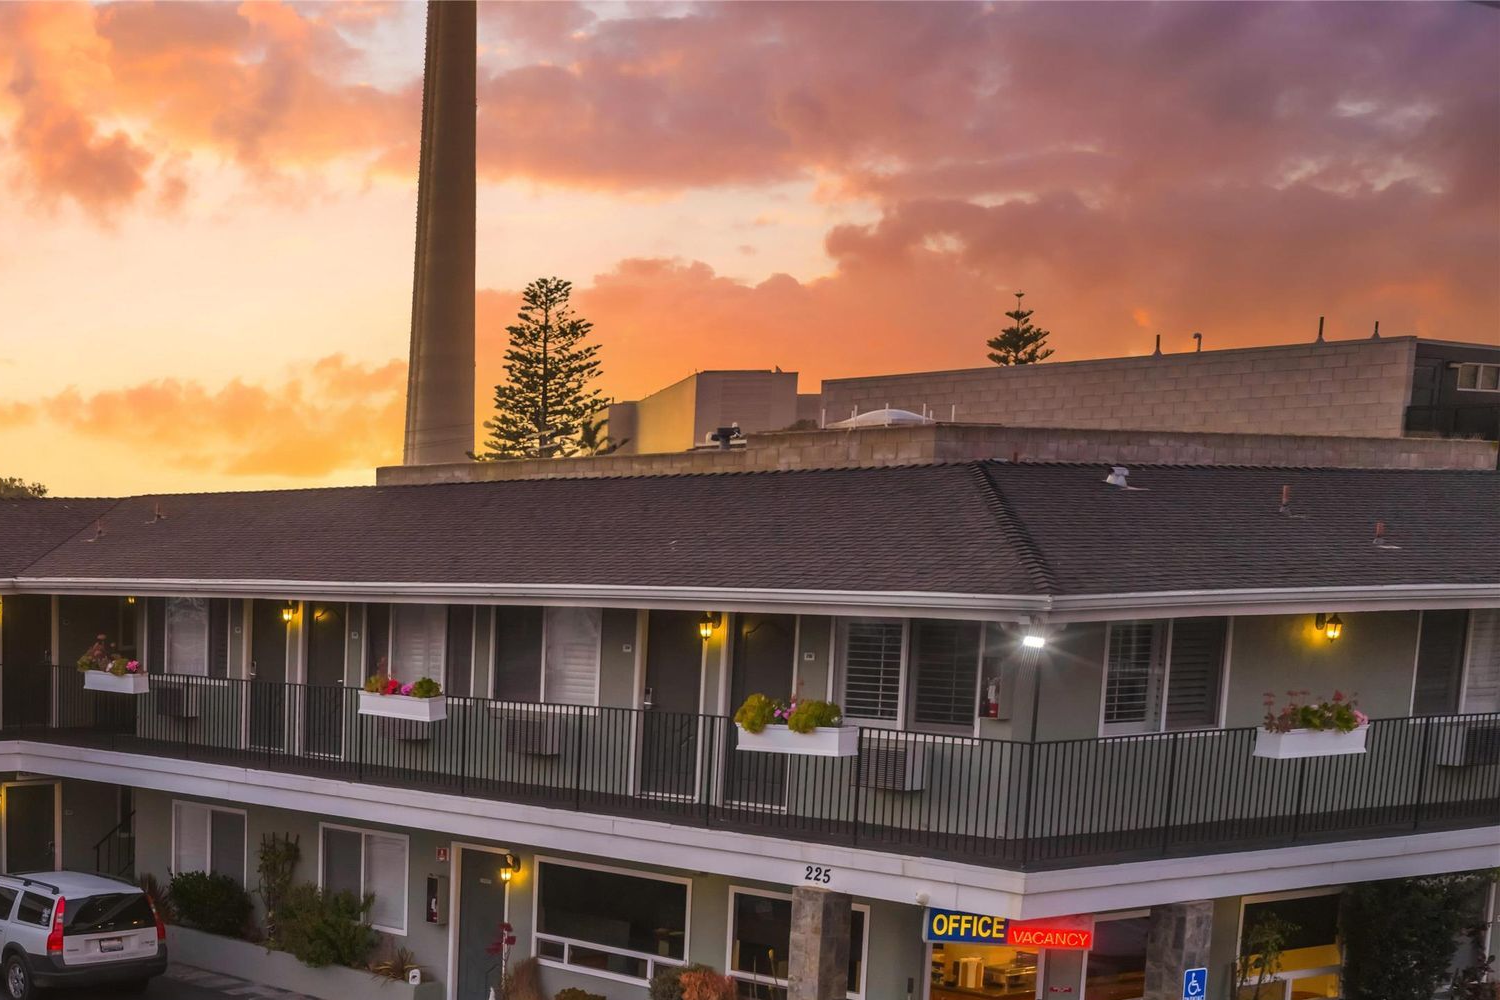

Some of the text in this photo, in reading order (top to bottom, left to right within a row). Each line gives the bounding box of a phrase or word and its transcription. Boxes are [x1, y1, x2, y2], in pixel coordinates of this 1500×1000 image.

[804, 865, 831, 884] 225
[932, 913, 1005, 939] OFFICE
[1013, 930, 1088, 946] VACANCY
